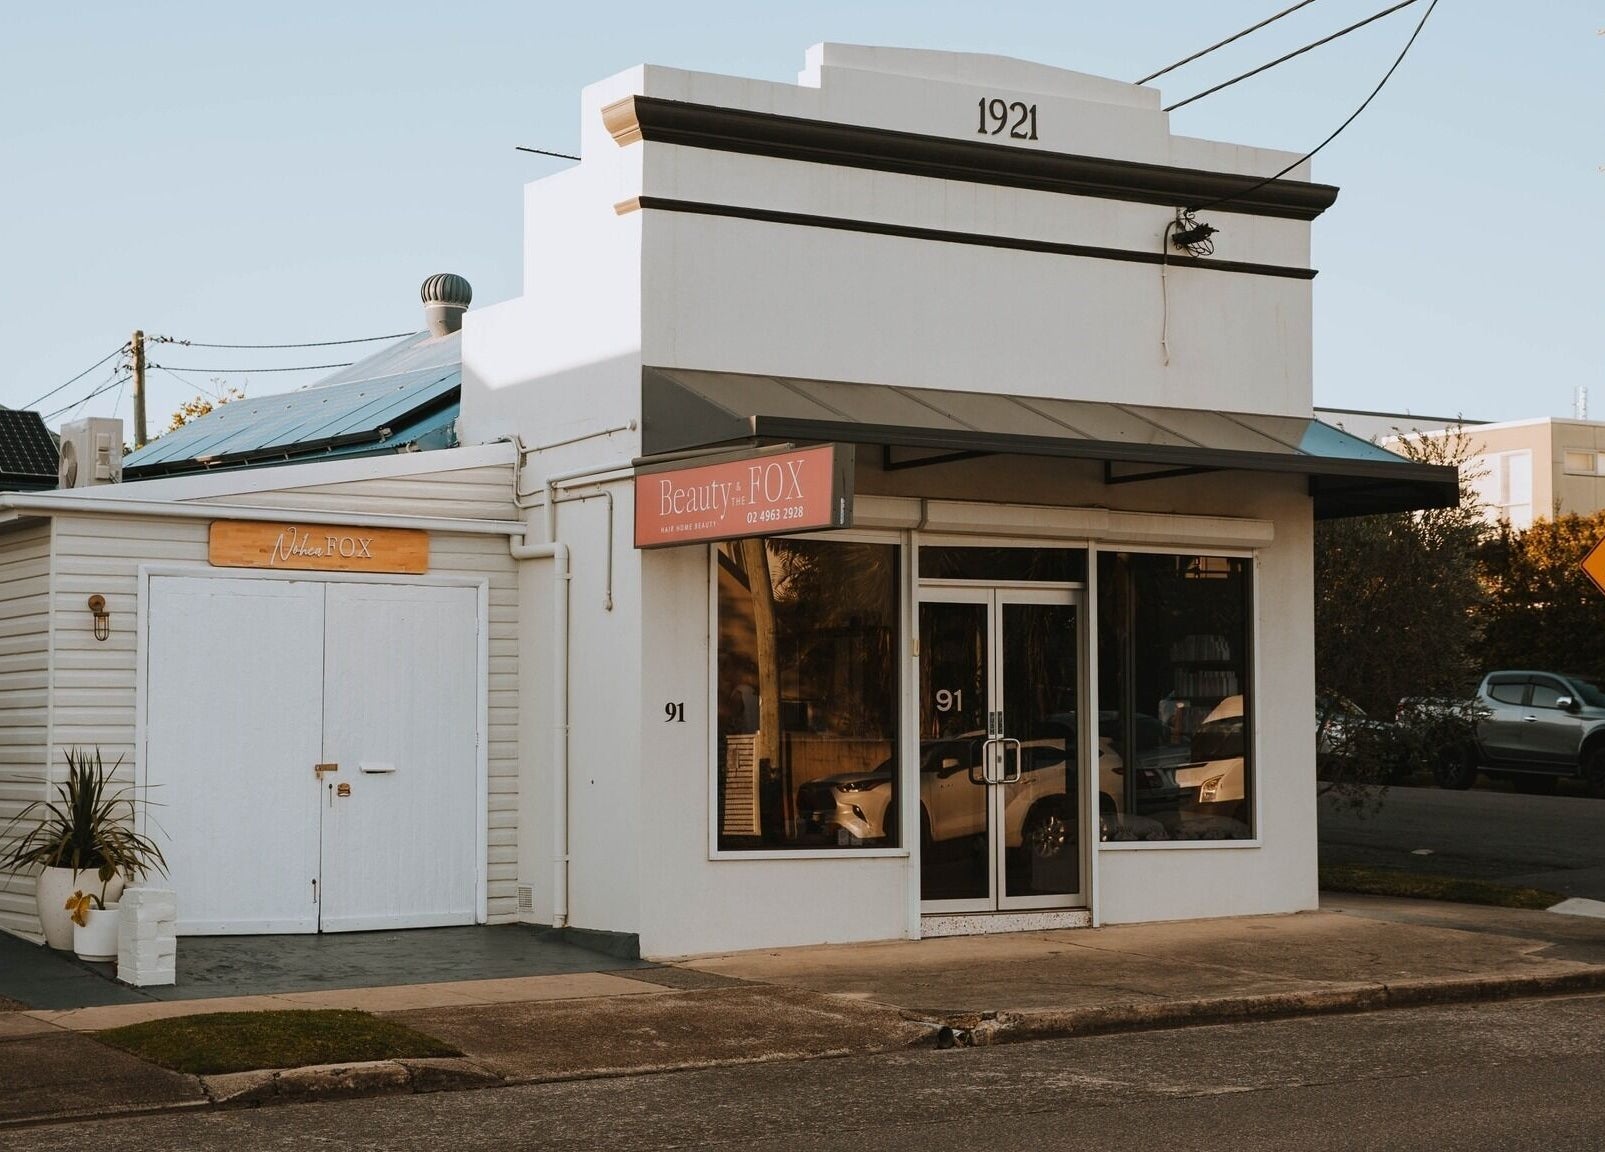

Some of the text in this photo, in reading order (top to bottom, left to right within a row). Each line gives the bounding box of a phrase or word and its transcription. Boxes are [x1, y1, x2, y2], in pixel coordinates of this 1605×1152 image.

[977, 97, 1038, 140] 1921
[660, 459, 805, 520] Beauty & THE FOX
[746, 505, 804, 524] 02 4963 2928
[660, 520, 716, 534] HAIR HOME BEAUTY
[325, 536, 375, 559] FOX
[936, 689, 962, 712] 91
[664, 702, 687, 723] 91
